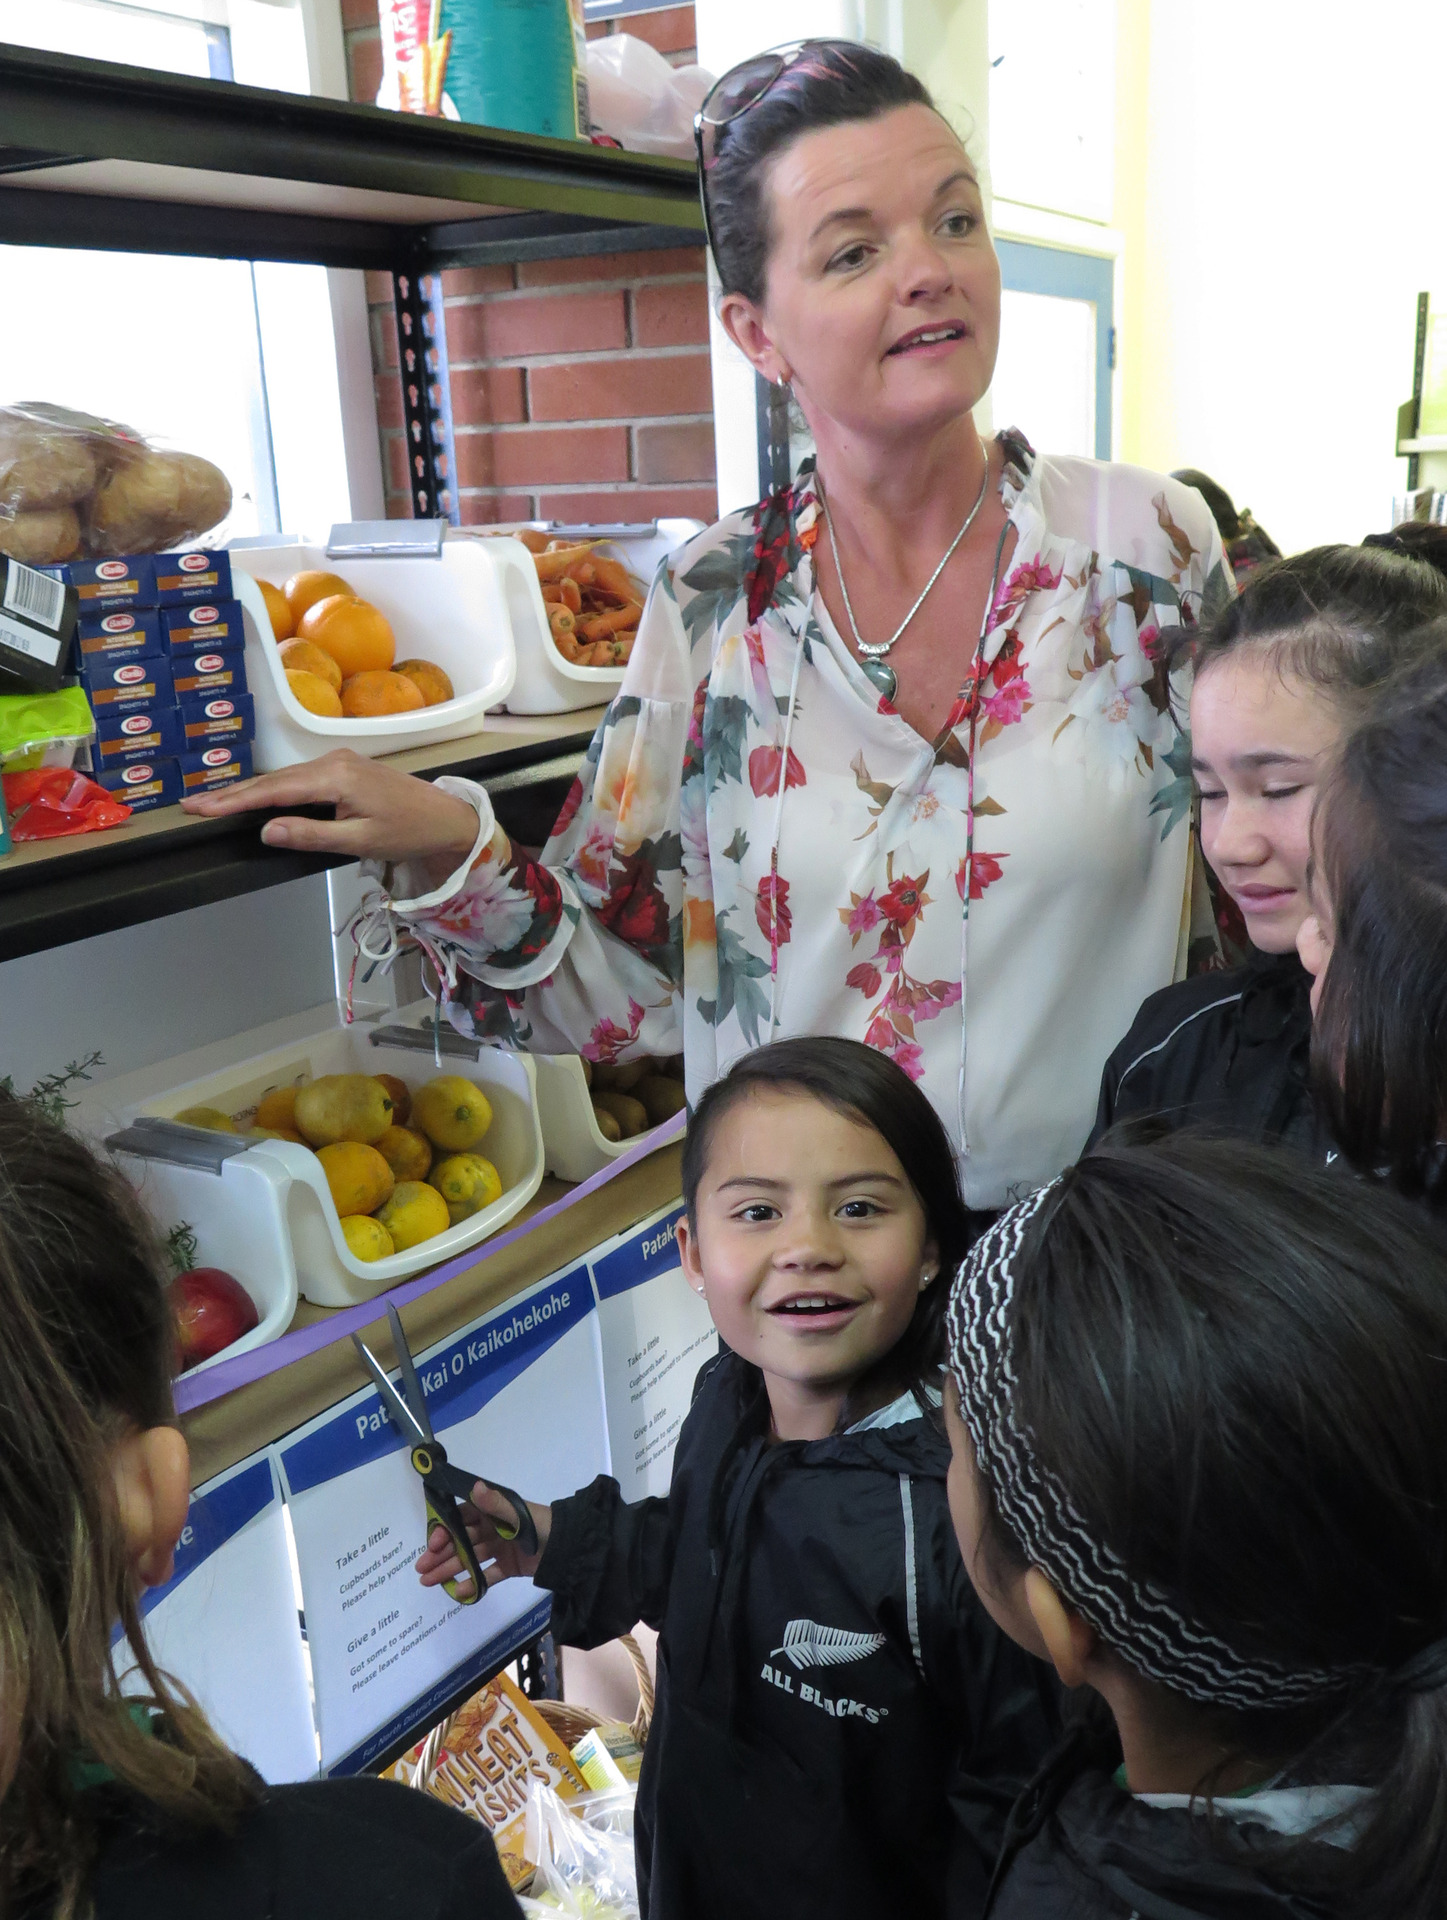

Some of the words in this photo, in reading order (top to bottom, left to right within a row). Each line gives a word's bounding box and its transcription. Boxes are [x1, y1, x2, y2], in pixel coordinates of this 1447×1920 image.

[421, 1362, 448, 1397] Kai
[451, 1354, 464, 1376] O
[466, 1291, 571, 1365] Kaikohekohe
[335, 1549, 359, 1570] Take
[360, 1543, 367, 1553] a
[368, 1527, 390, 1547] little
[339, 1560, 382, 1594] Cupboards
[382, 1541, 403, 1564] bare?
[341, 1589, 368, 1611] Please
[368, 1575, 386, 1592] help
[387, 1549, 417, 1580] yourself
[417, 1544, 426, 1556] to
[347, 1633, 369, 1654] Give
[370, 1627, 377, 1637] a
[378, 1609, 400, 1631] little
[350, 1660, 365, 1677] Got
[366, 1644, 388, 1665] some
[388, 1637, 398, 1648] to
[398, 1615, 423, 1643] spare?
[351, 1668, 378, 1693] Please
[378, 1652, 399, 1673] leave
[400, 1624, 437, 1656] donations
[438, 1614, 447, 1627] of
[760, 1663, 794, 1694] ALL
[427, 1711, 533, 1808] WHEAT
